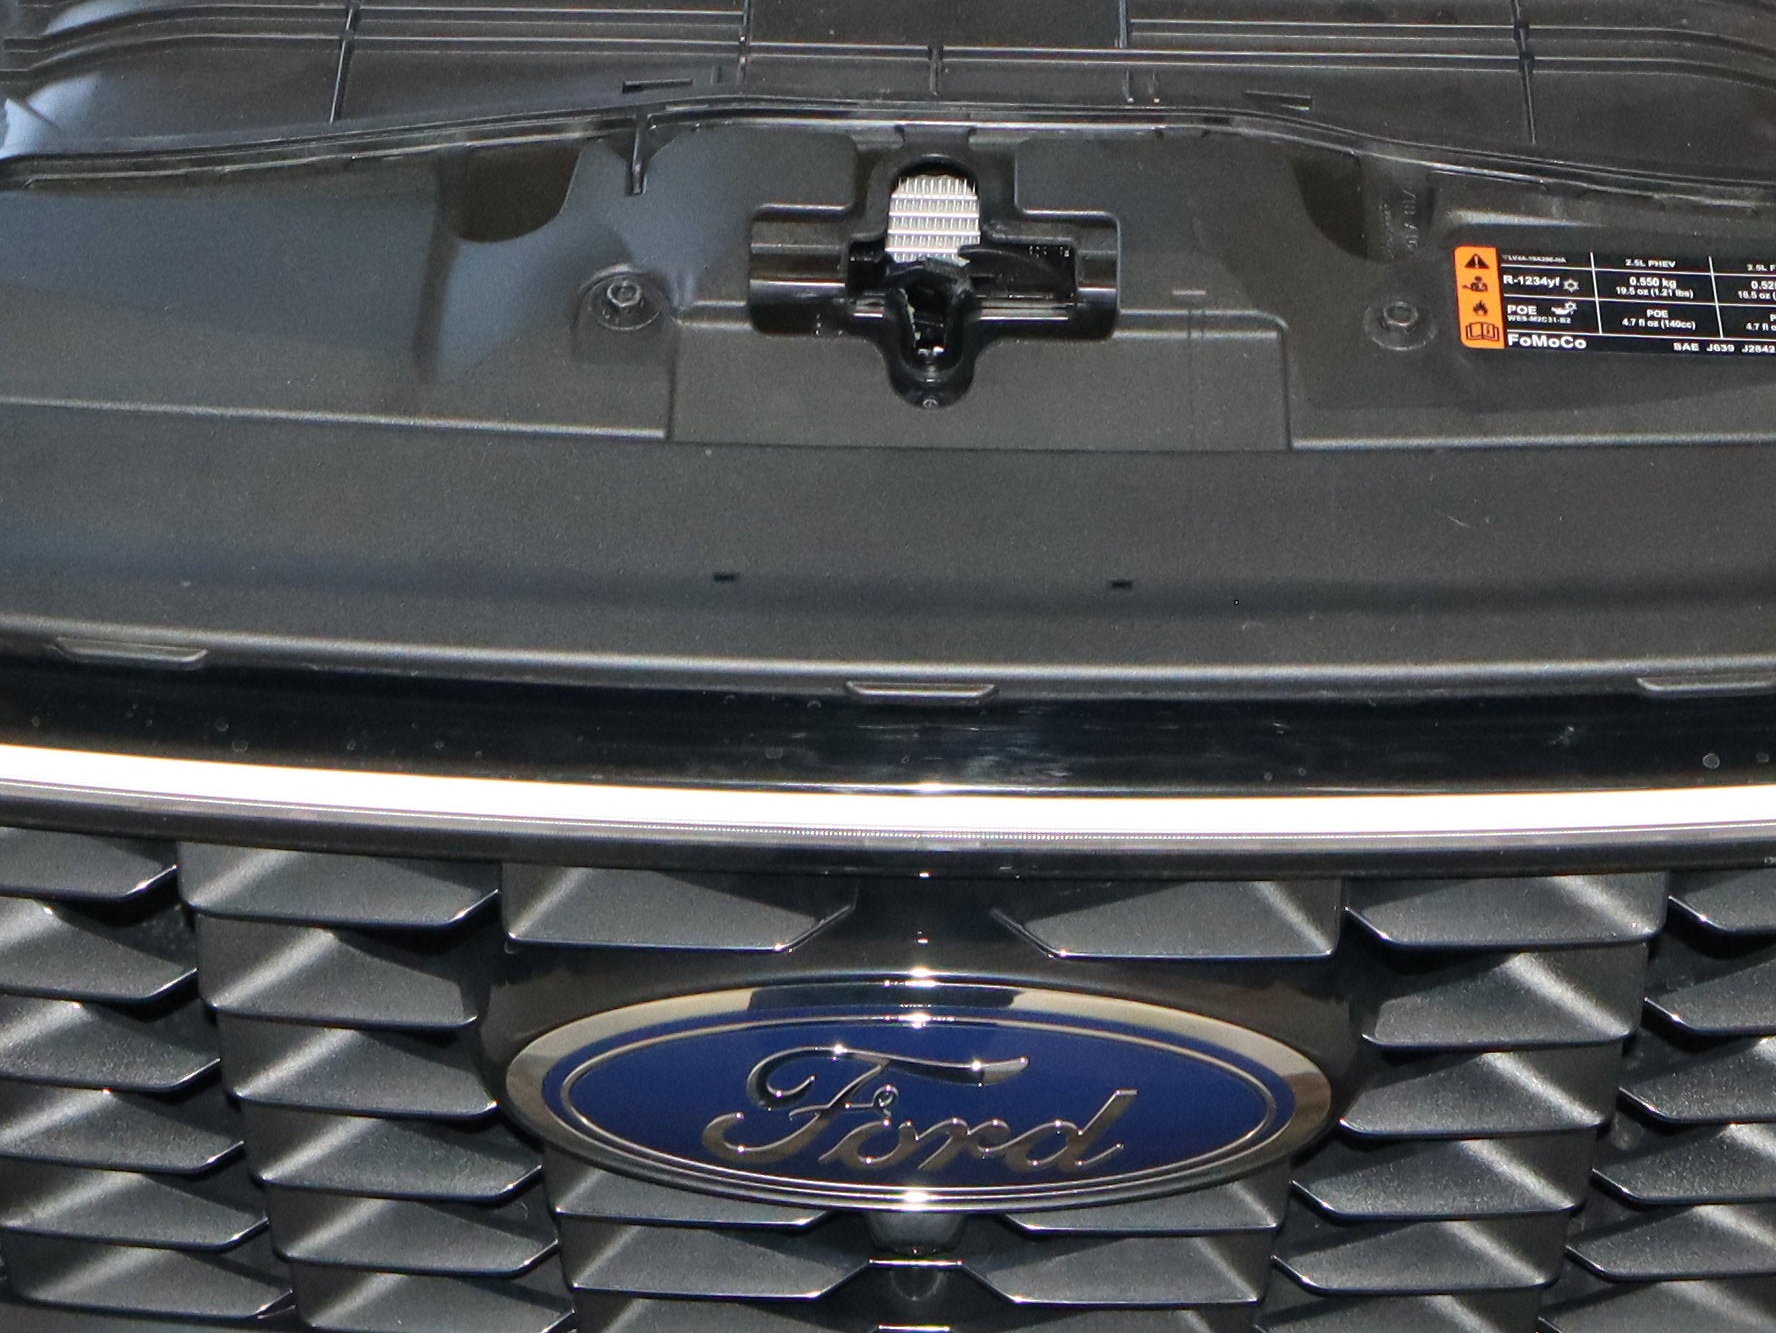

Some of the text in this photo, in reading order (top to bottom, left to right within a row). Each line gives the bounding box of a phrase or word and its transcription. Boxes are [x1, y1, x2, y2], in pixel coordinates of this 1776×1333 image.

[1503, 274, 1560, 288] R-1234yf
[1629, 276, 1677, 289] 0.550 kg
[1675, 289, 1694, 299] lbs)
[1759, 292, 1771, 300] oz
[1507, 304, 1537, 316] POE
[1646, 309, 1669, 318] POE
[1622, 318, 1636, 326] 4.7
[1647, 320, 1659, 328] oz
[1746, 323, 1760, 331] 4.7
[1507, 334, 1587, 349] FoMoCo
[1673, 343, 1700, 352] SAE
[1706, 343, 1735, 353] J639
[703, 1045, 1138, 1174] Ford
